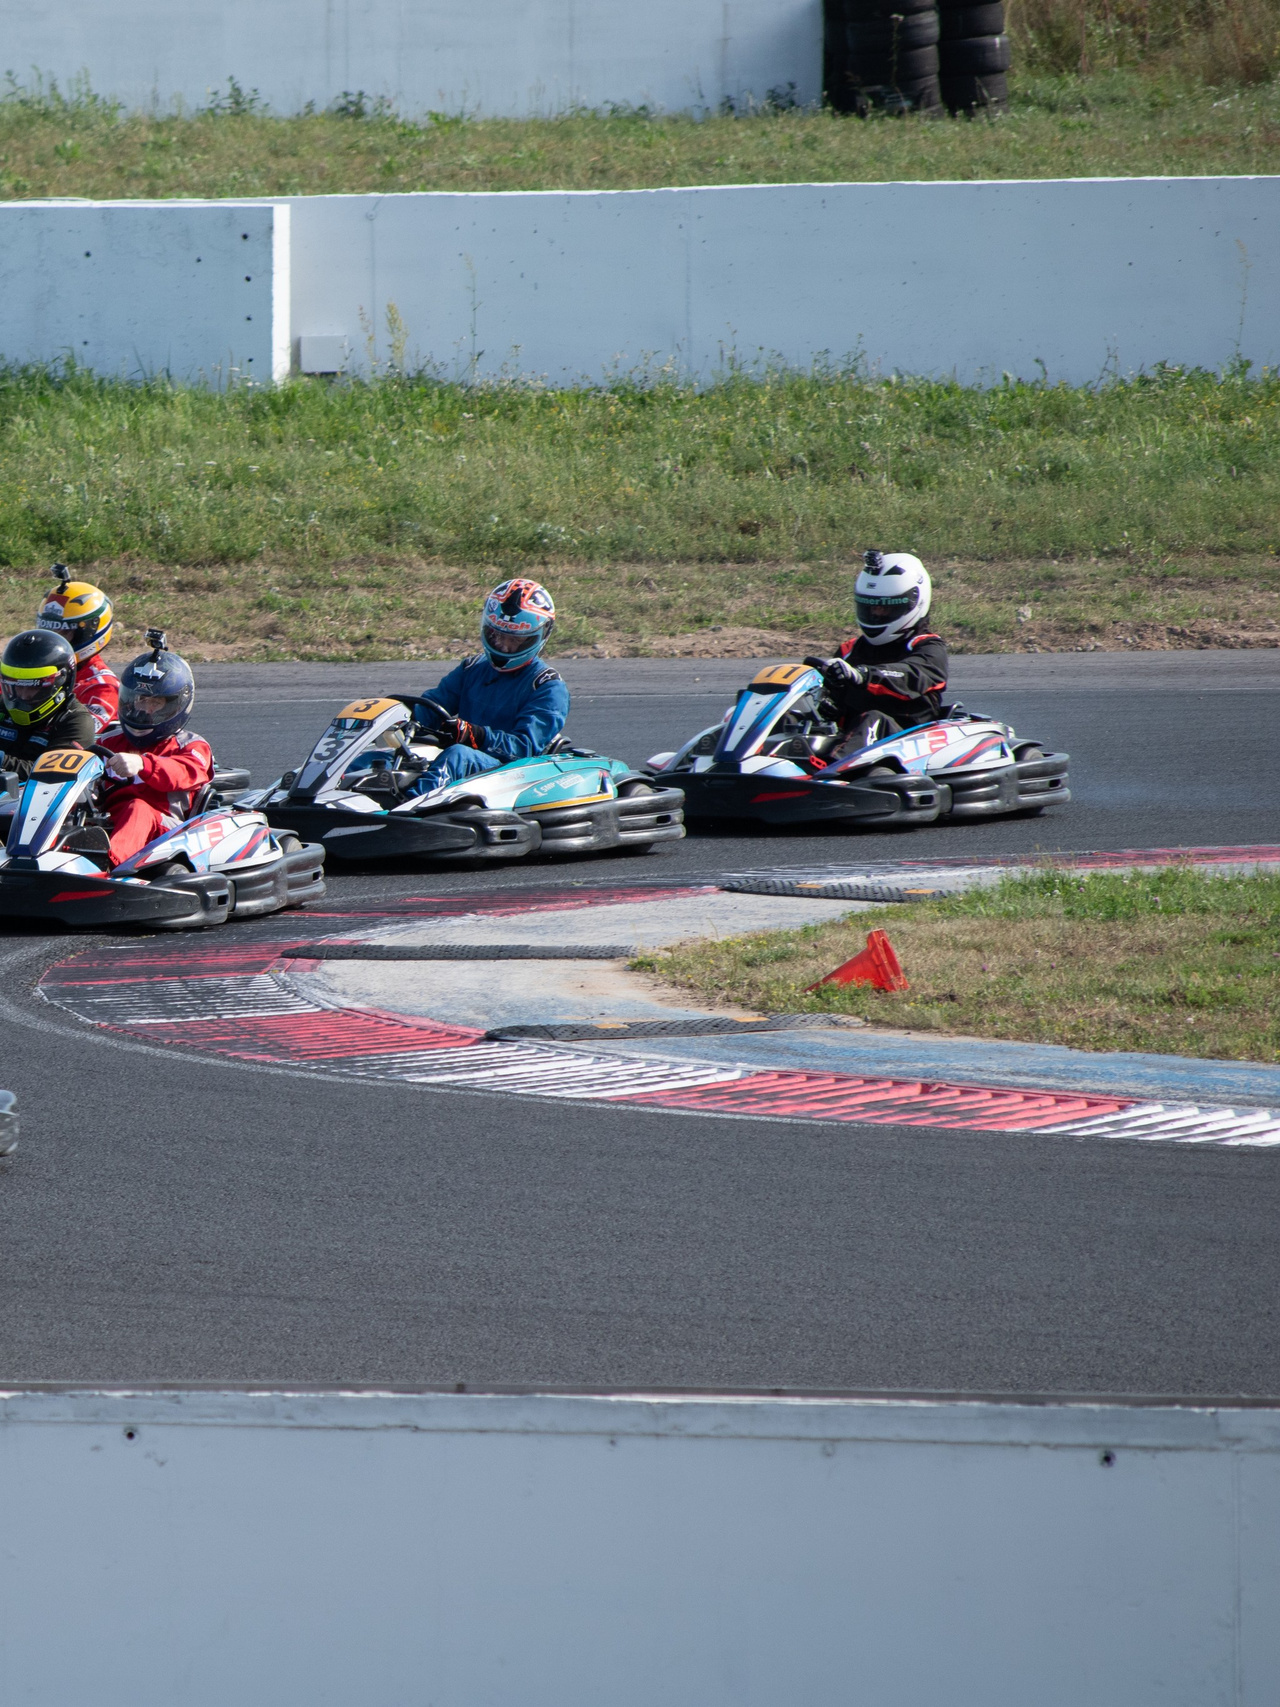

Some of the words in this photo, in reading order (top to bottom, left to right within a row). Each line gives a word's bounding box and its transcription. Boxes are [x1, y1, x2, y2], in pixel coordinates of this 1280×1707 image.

[488, 613, 531, 630] Airoh
[766, 666, 800, 679] 11
[353, 700, 380, 713] 3
[314, 740, 346, 761] 3
[40, 754, 84, 770] 20
